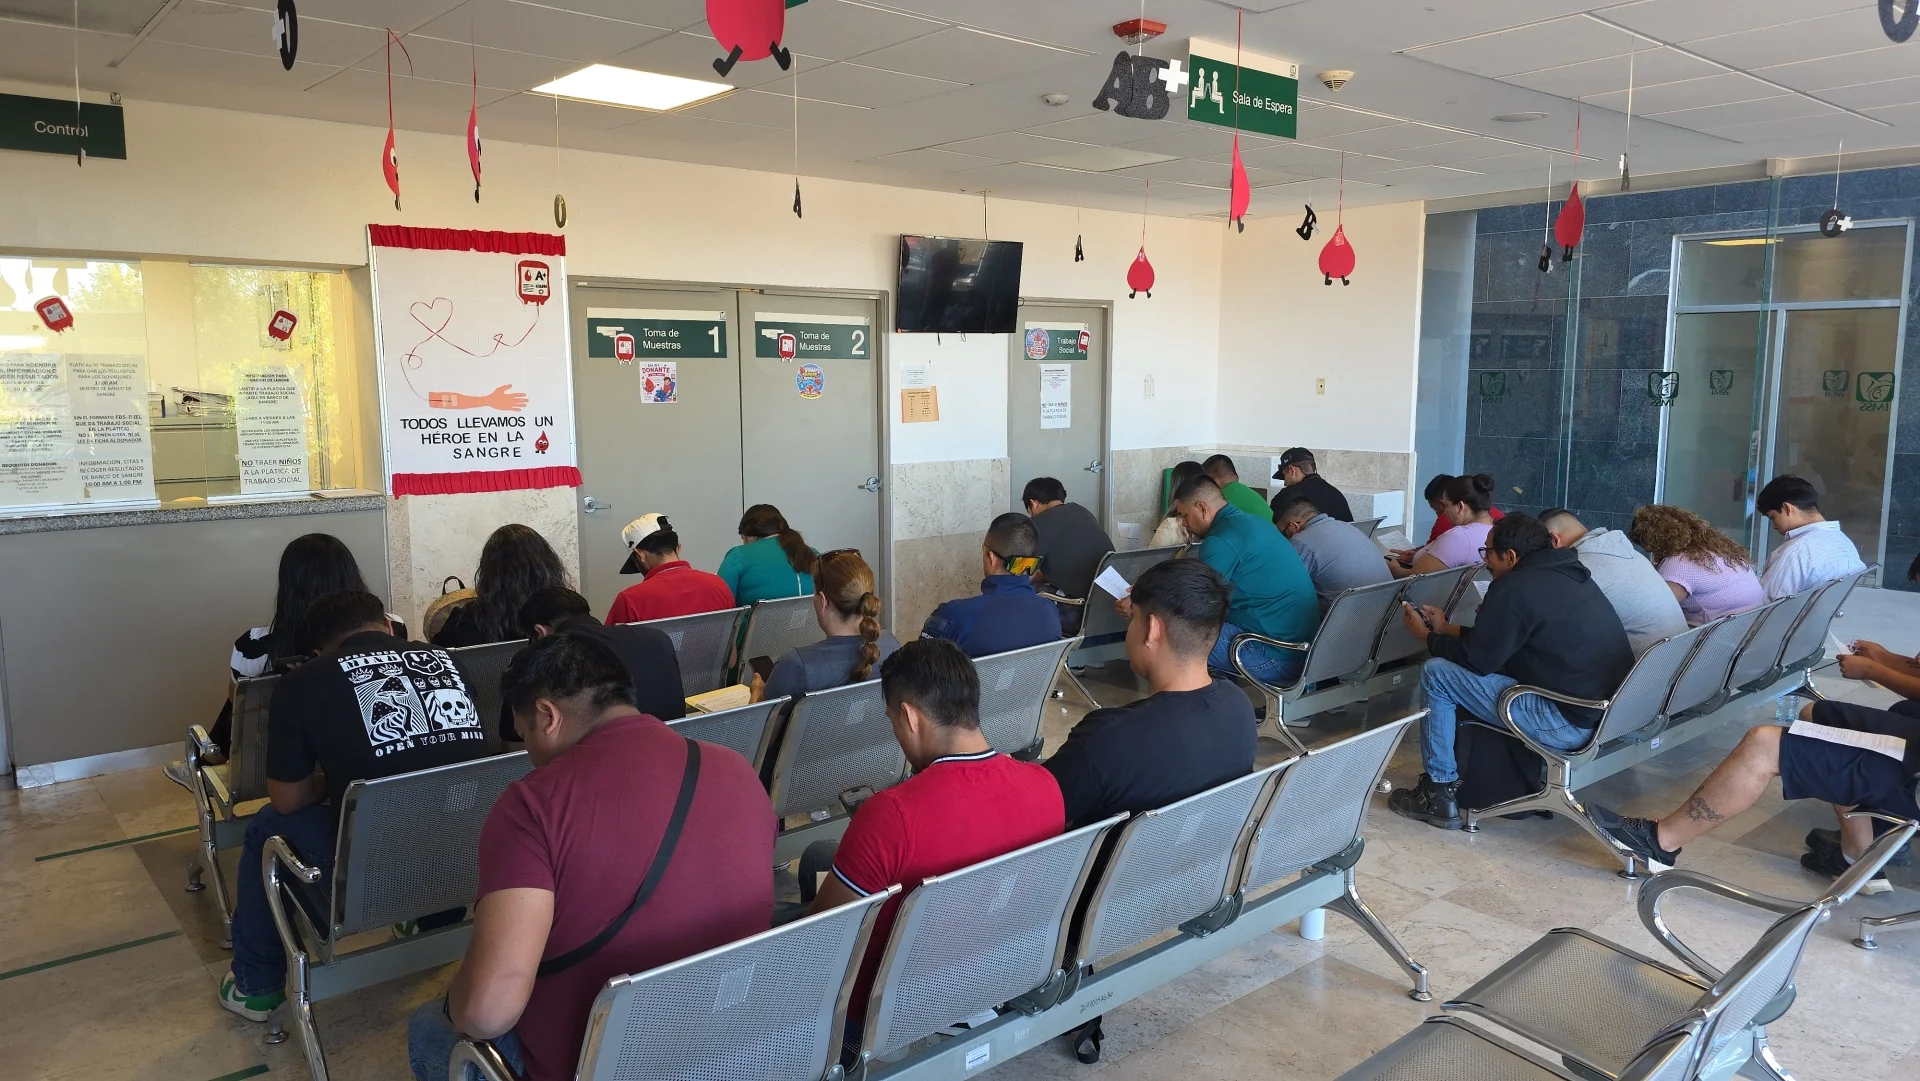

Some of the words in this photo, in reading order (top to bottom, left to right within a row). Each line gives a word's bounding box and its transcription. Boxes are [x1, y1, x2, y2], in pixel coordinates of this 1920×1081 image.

[1232, 90, 1251, 106] Sala
[1253, 96, 1263, 108] de
[1265, 98, 1293, 114] Espera
[34, 121, 88, 137] Control
[643, 328, 666, 337] Toma
[668, 328, 679, 337] de
[708, 326, 719, 353] 1
[643, 341, 681, 349] Muestras
[800, 331, 819, 339] Toma
[820, 332, 830, 340] de
[852, 330, 865, 355] 2
[1057, 337, 1076, 346] Trabajo
[800, 342, 831, 351] Muestras
[400, 417, 448, 429] TODOS
[457, 416, 526, 429] LLEVAMOS
[534, 415, 554, 427] UN
[421, 431, 471, 445] HÉROE
[478, 432, 498, 443] EN
[507, 431, 525, 442] LA
[453, 446, 522, 459] SANGRE
[279, 457, 302, 465] NIÑOS
[261, 467, 289, 475] PLATICA
[243, 477, 276, 485] TRABAJO
[277, 476, 302, 484] SOCIAL
[375, 739, 415, 757] OPEN
[420, 732, 457, 746] YOUR
